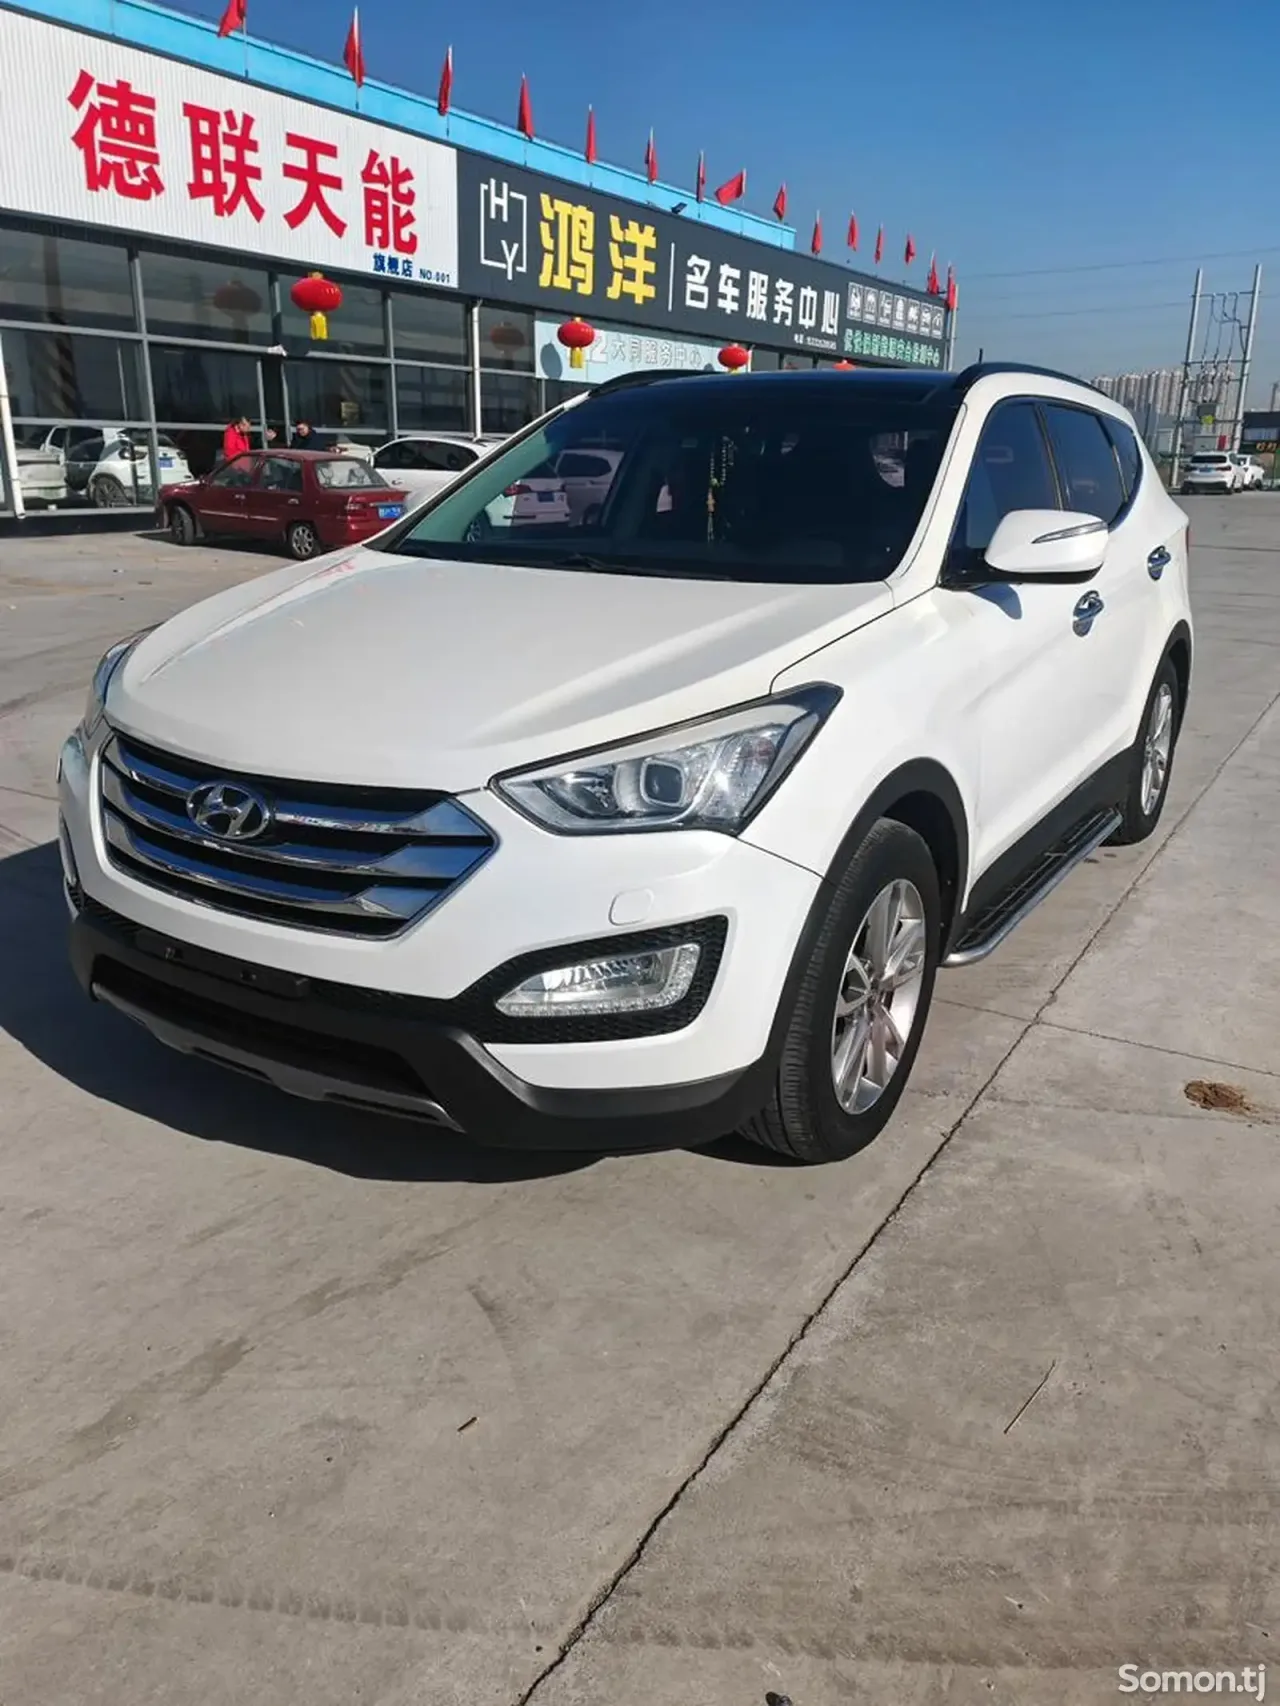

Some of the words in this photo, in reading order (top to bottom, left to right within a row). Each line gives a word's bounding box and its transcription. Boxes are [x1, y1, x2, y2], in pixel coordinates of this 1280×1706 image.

[67, 69, 418, 255] 德联天能
[538, 192, 657, 304] 鸿洋
[684, 253, 841, 336] 名车服务中心
